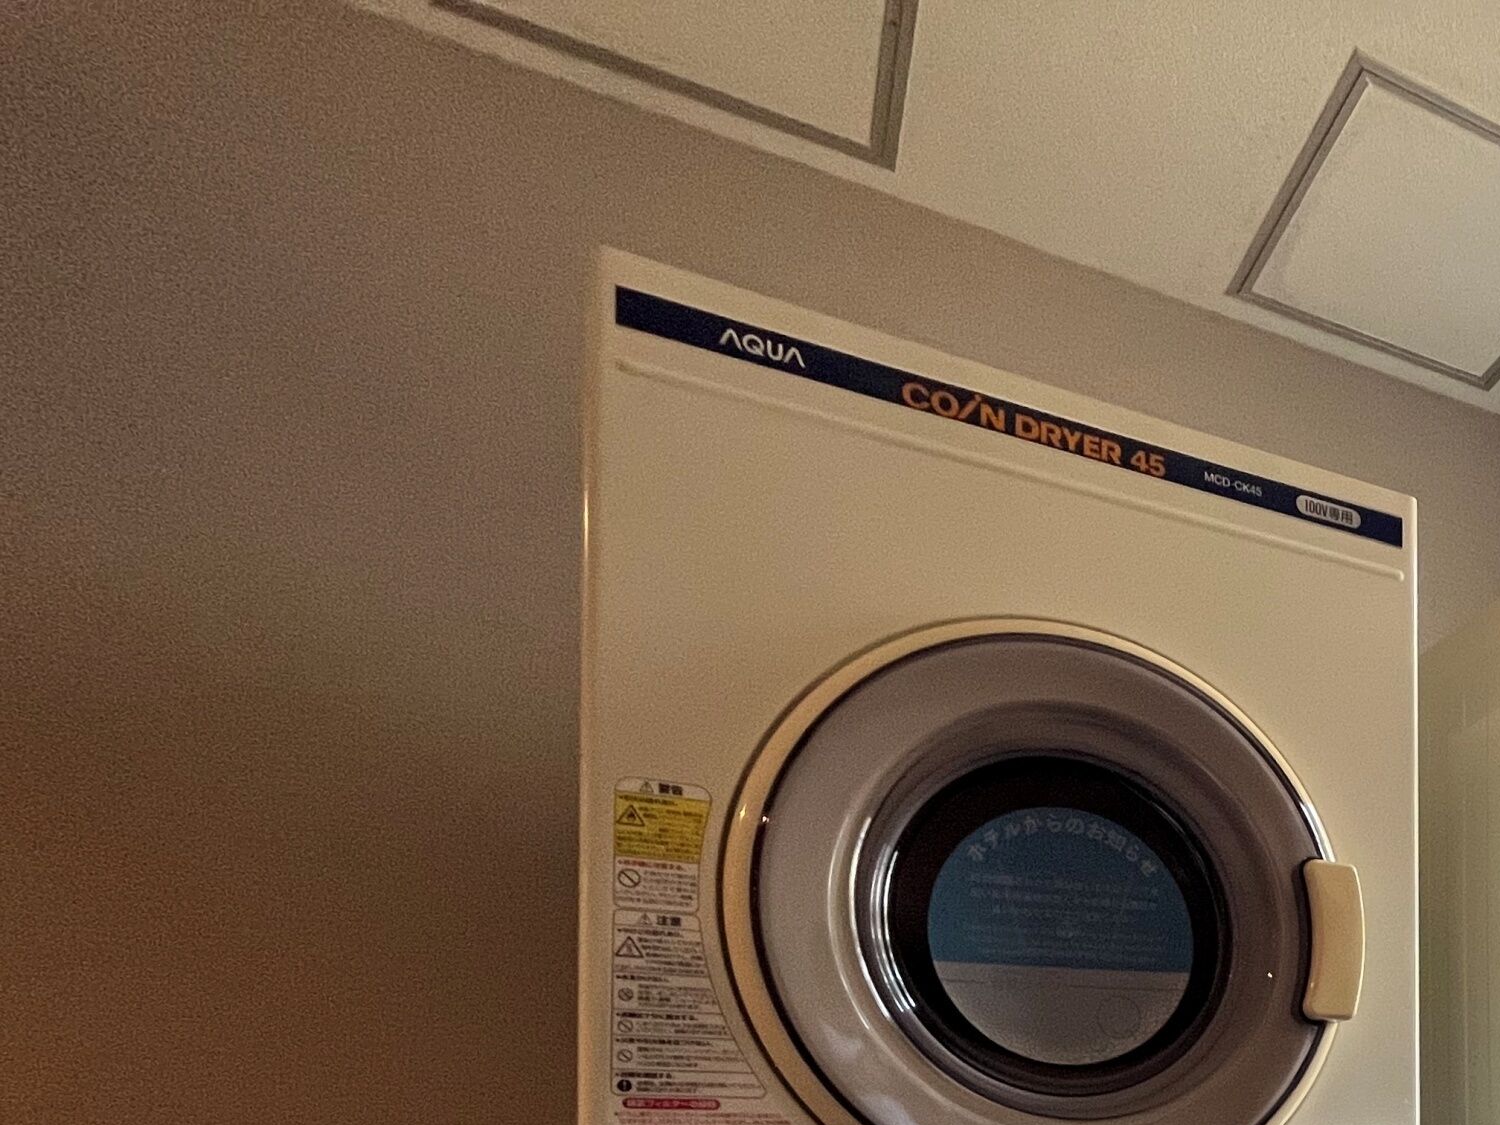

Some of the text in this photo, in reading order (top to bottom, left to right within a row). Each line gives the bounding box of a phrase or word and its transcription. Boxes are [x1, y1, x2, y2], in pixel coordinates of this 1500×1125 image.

[719, 327, 806, 369] AQUA
[902, 381, 1166, 479] COIN DRYER 45
[1203, 470, 1263, 498] MCD-CK45
